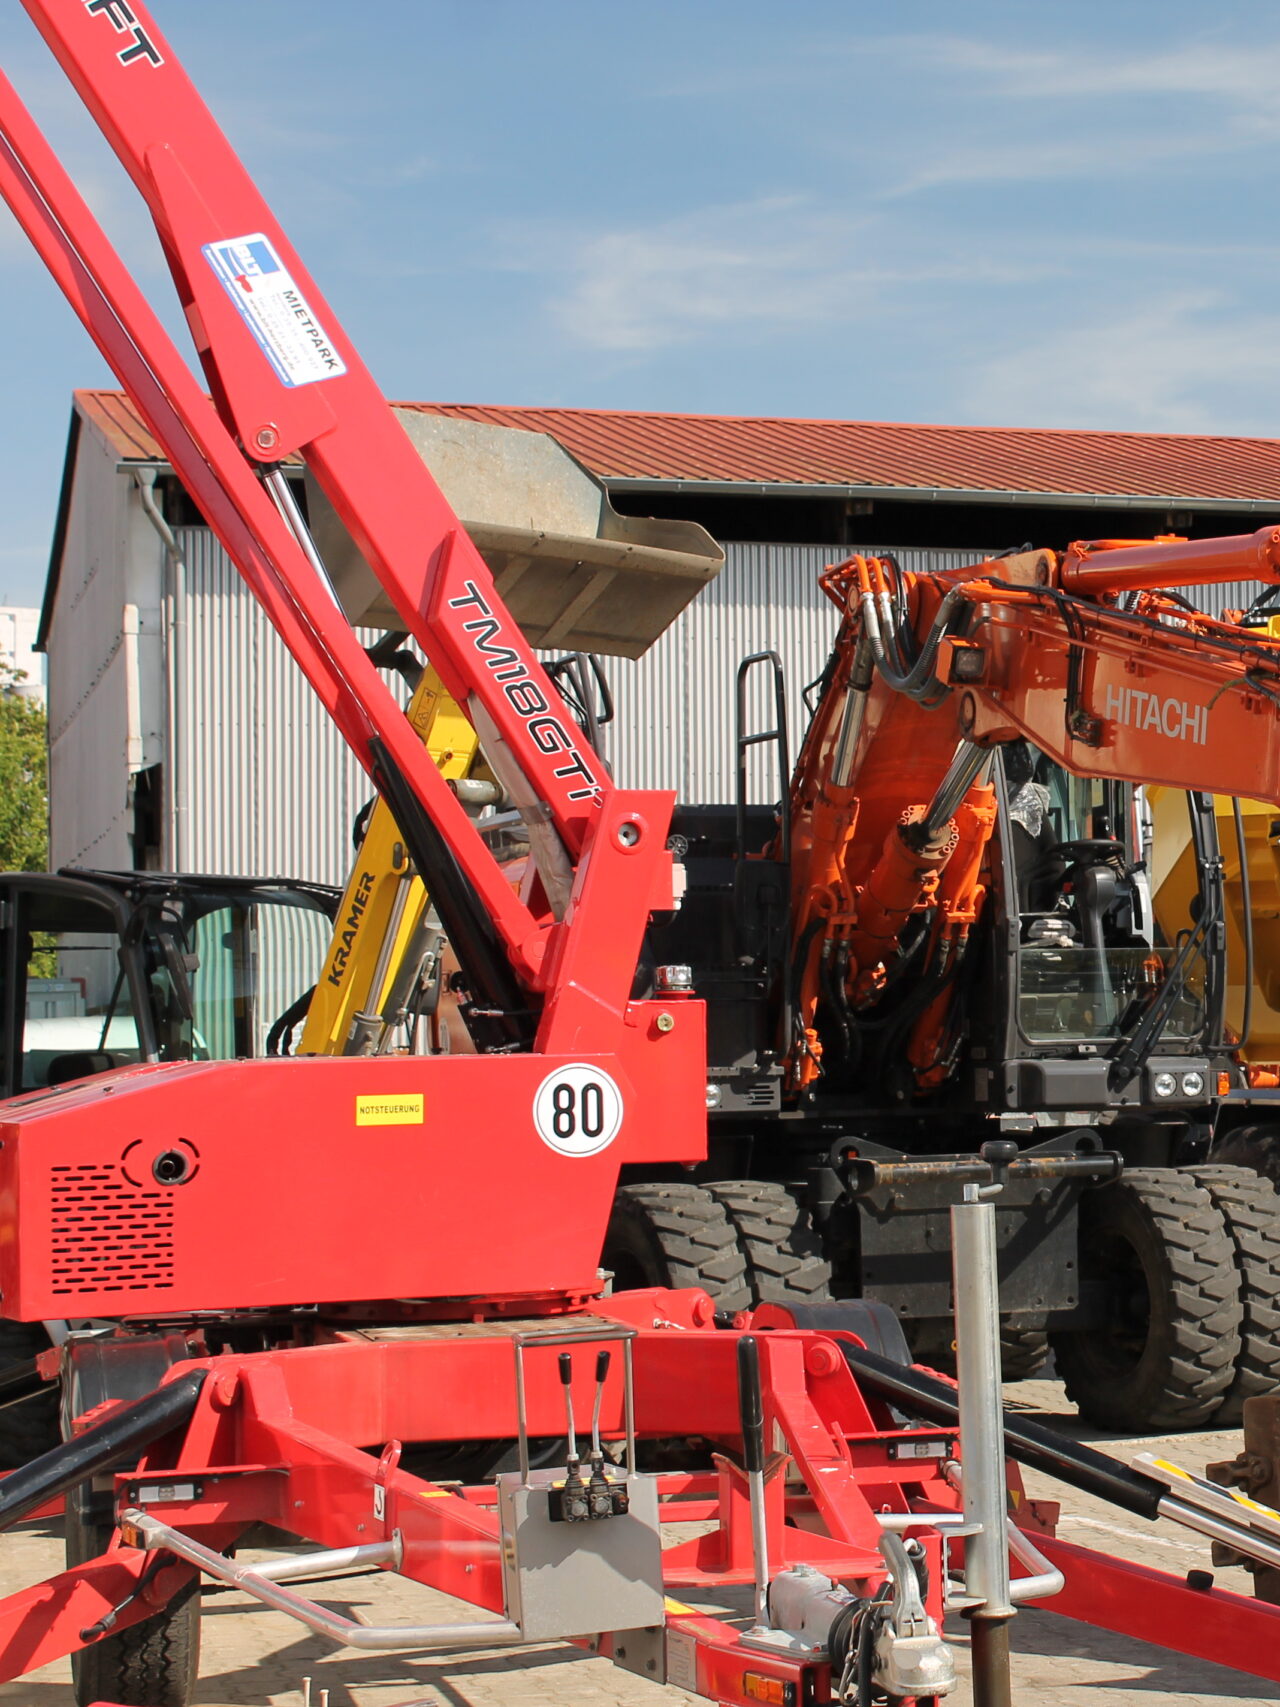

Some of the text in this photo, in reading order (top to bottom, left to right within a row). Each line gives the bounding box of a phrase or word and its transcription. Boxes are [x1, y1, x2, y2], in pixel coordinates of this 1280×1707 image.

[83, 0, 165, 68] FT
[231, 243, 265, 276] BLT
[282, 289, 339, 371] MIETPARK
[1104, 683, 1209, 746] HITACHI
[327, 871, 377, 988] KRAMER
[359, 1103, 421, 1115] NOTSTEUERUNG
[552, 1081, 605, 1140] 80
